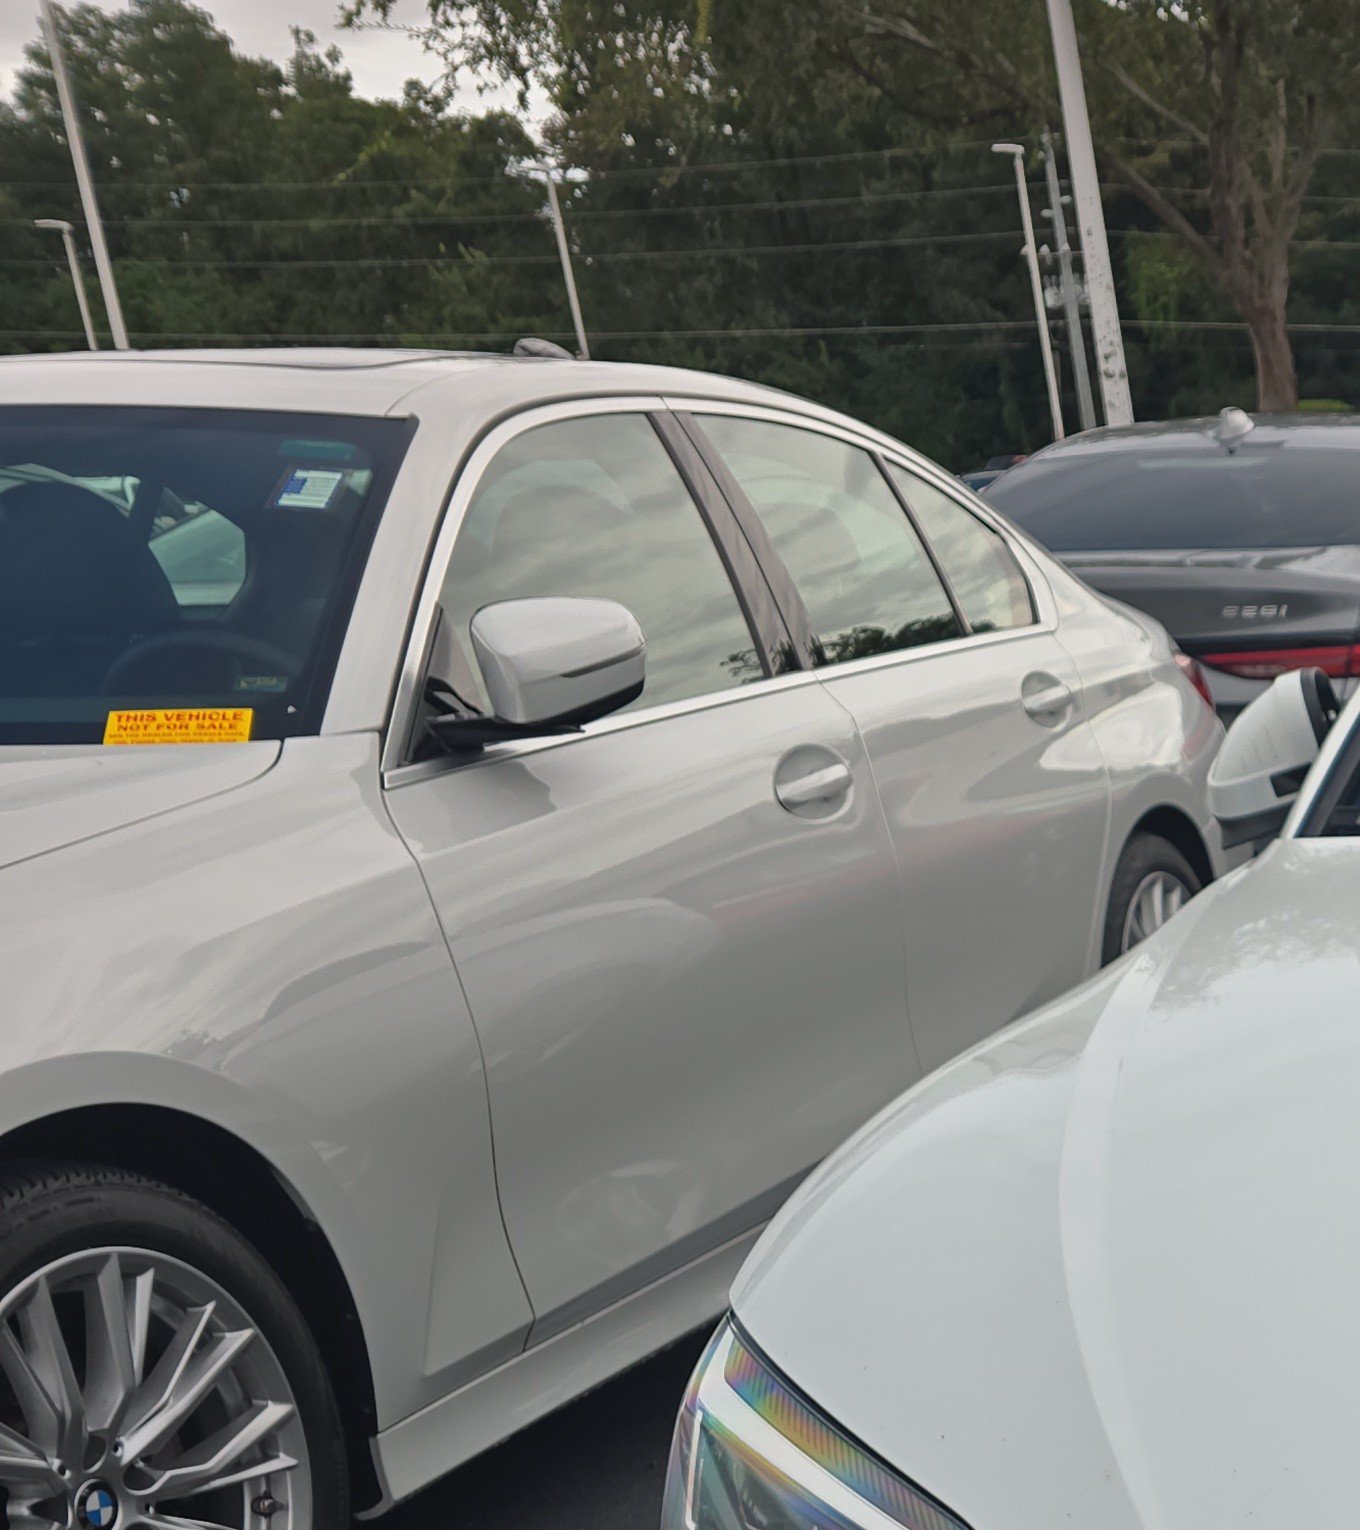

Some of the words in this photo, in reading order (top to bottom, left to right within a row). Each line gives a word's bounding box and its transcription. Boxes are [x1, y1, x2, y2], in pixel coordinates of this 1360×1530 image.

[115, 712, 157, 723] THIS
[164, 711, 244, 722] VEHICLE
[116, 724, 149, 732] NOT
[156, 723, 189, 731] FOR
[195, 722, 238, 730] SALE
